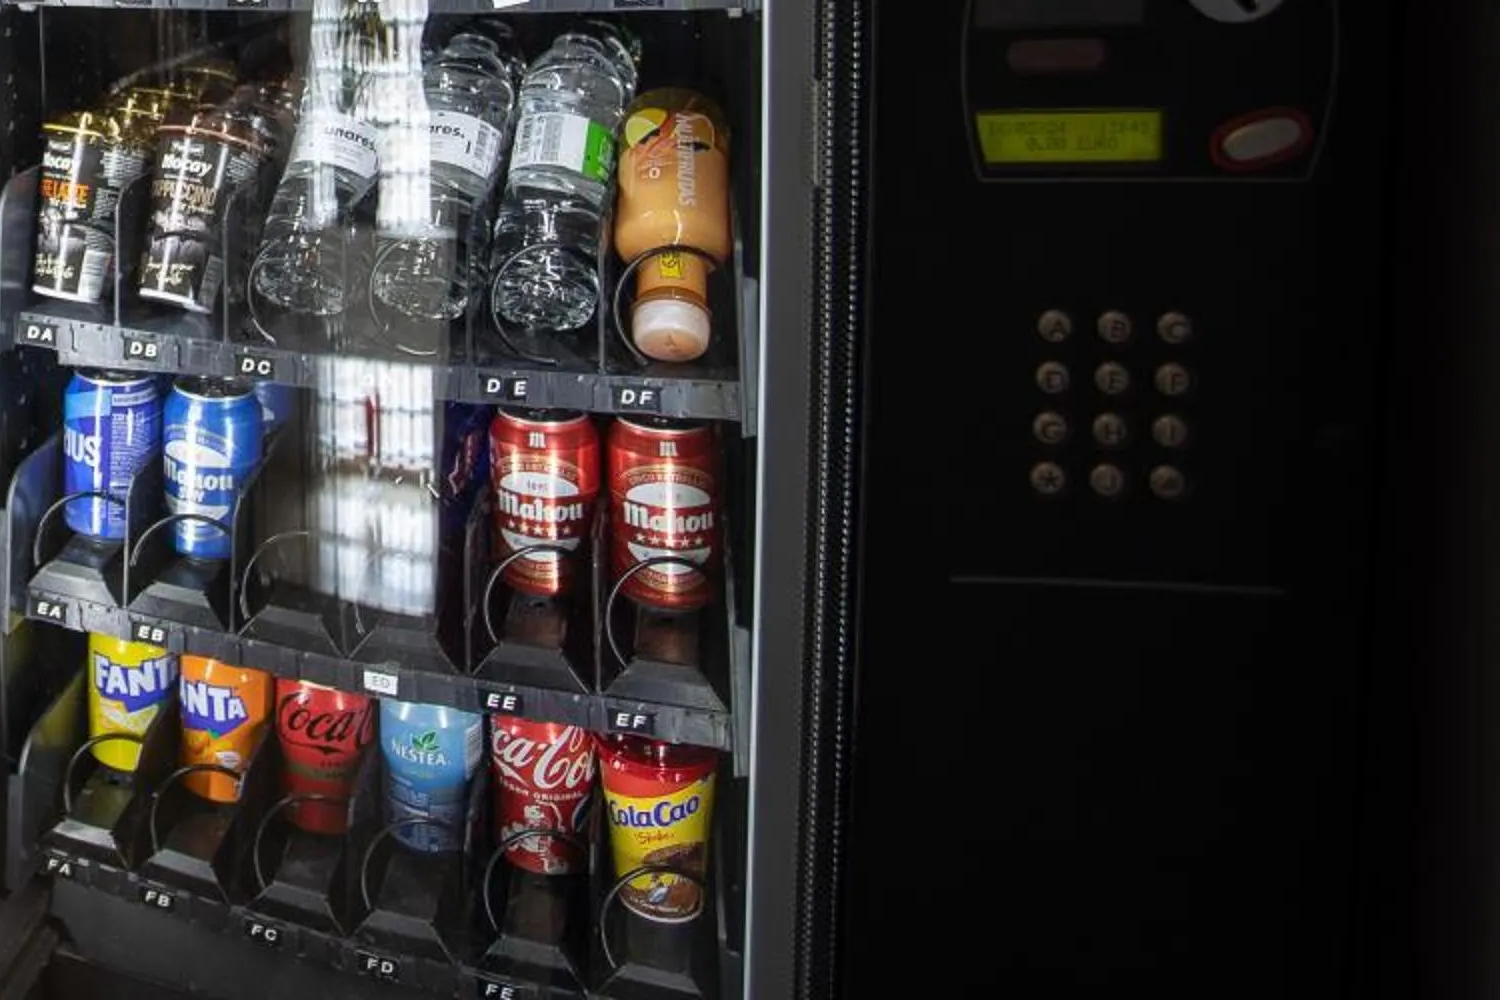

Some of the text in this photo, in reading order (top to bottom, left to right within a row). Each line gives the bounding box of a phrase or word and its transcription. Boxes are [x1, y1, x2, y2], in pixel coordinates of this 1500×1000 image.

[27, 327, 53, 342] DA
[130, 342, 157, 358] DB
[241, 358, 271, 375] DC
[621, 388, 654, 405] DF
[37, 602, 61, 618] EA
[138, 625, 164, 642] EB
[487, 693, 517, 710] EE
[616, 712, 646, 728] EF
[391, 738, 447, 767] NESTEA
[609, 795, 699, 828] ColaCao
[47, 859, 72, 876] FA
[145, 891, 171, 908] FB
[251, 926, 277, 941] FC
[367, 957, 393, 974] FD
[485, 983, 514, 1000] FE
